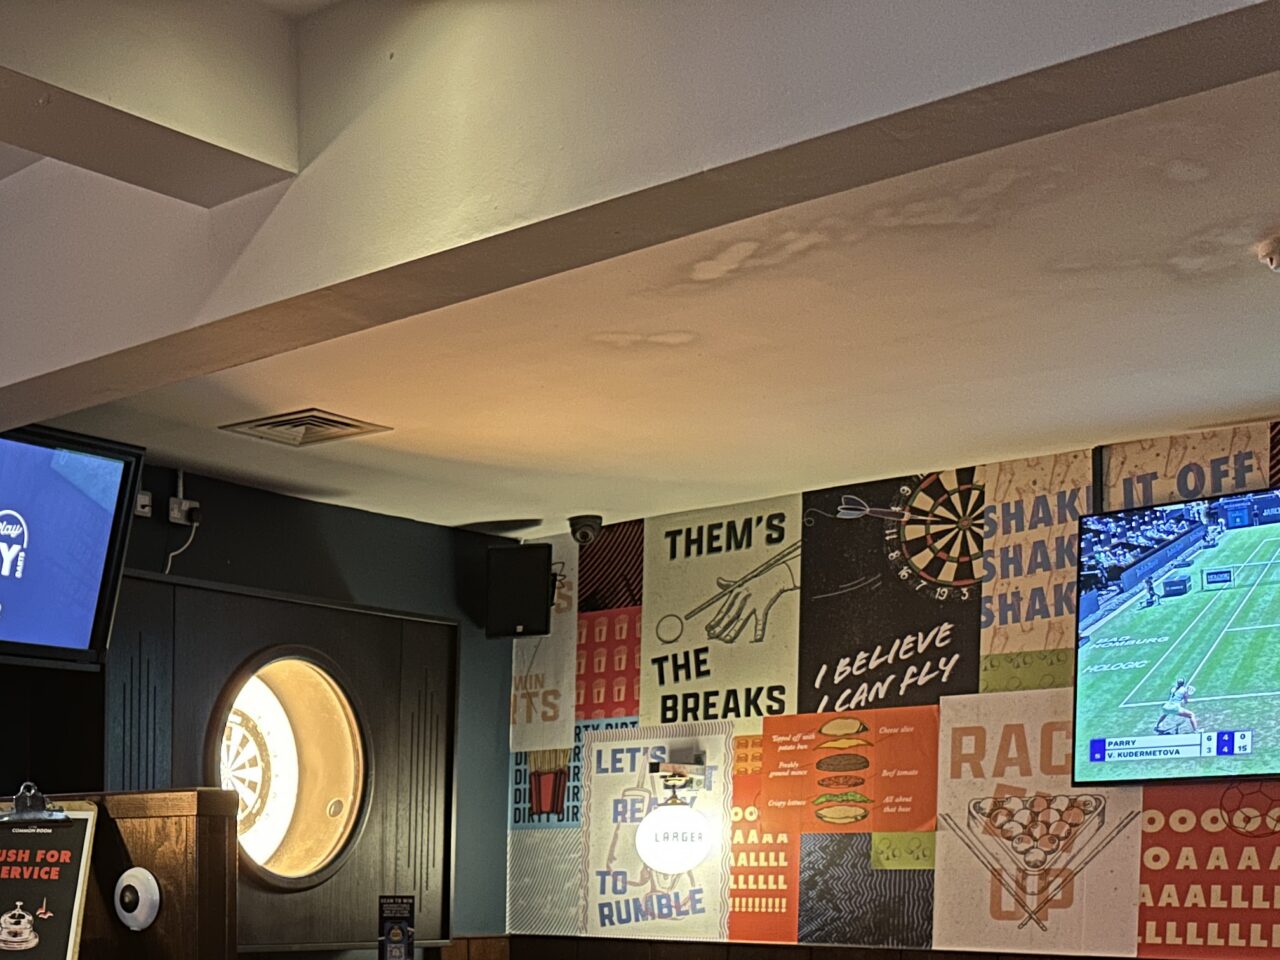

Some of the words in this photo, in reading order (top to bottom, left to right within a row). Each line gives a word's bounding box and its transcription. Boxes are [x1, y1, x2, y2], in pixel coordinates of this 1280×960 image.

[1122, 471, 1158, 508] IT
[1176, 450, 1254, 500] OFF
[664, 512, 786, 561] THEM'S
[982, 533, 1078, 583] SHAK
[980, 581, 1077, 629] SHAK
[651, 646, 711, 686] THE
[814, 664, 827, 689] I
[833, 621, 954, 685] BELIEVE
[1082, 660, 1149, 673] HOLOGIC
[834, 674, 896, 713] CAN
[899, 653, 960, 696] FLY
[660, 685, 786, 724] BREAKS
[596, 746, 667, 774] LET'S
[950, 720, 1072, 780] RAC
[1117, 749, 1180, 758] KUDERMETOVA
[36, 850, 72, 863] FOR
[655, 831, 703, 843] LARGER
[596, 870, 628, 896] TO
[990, 868, 1074, 922] UP
[598, 888, 706, 928] RUMBLE
